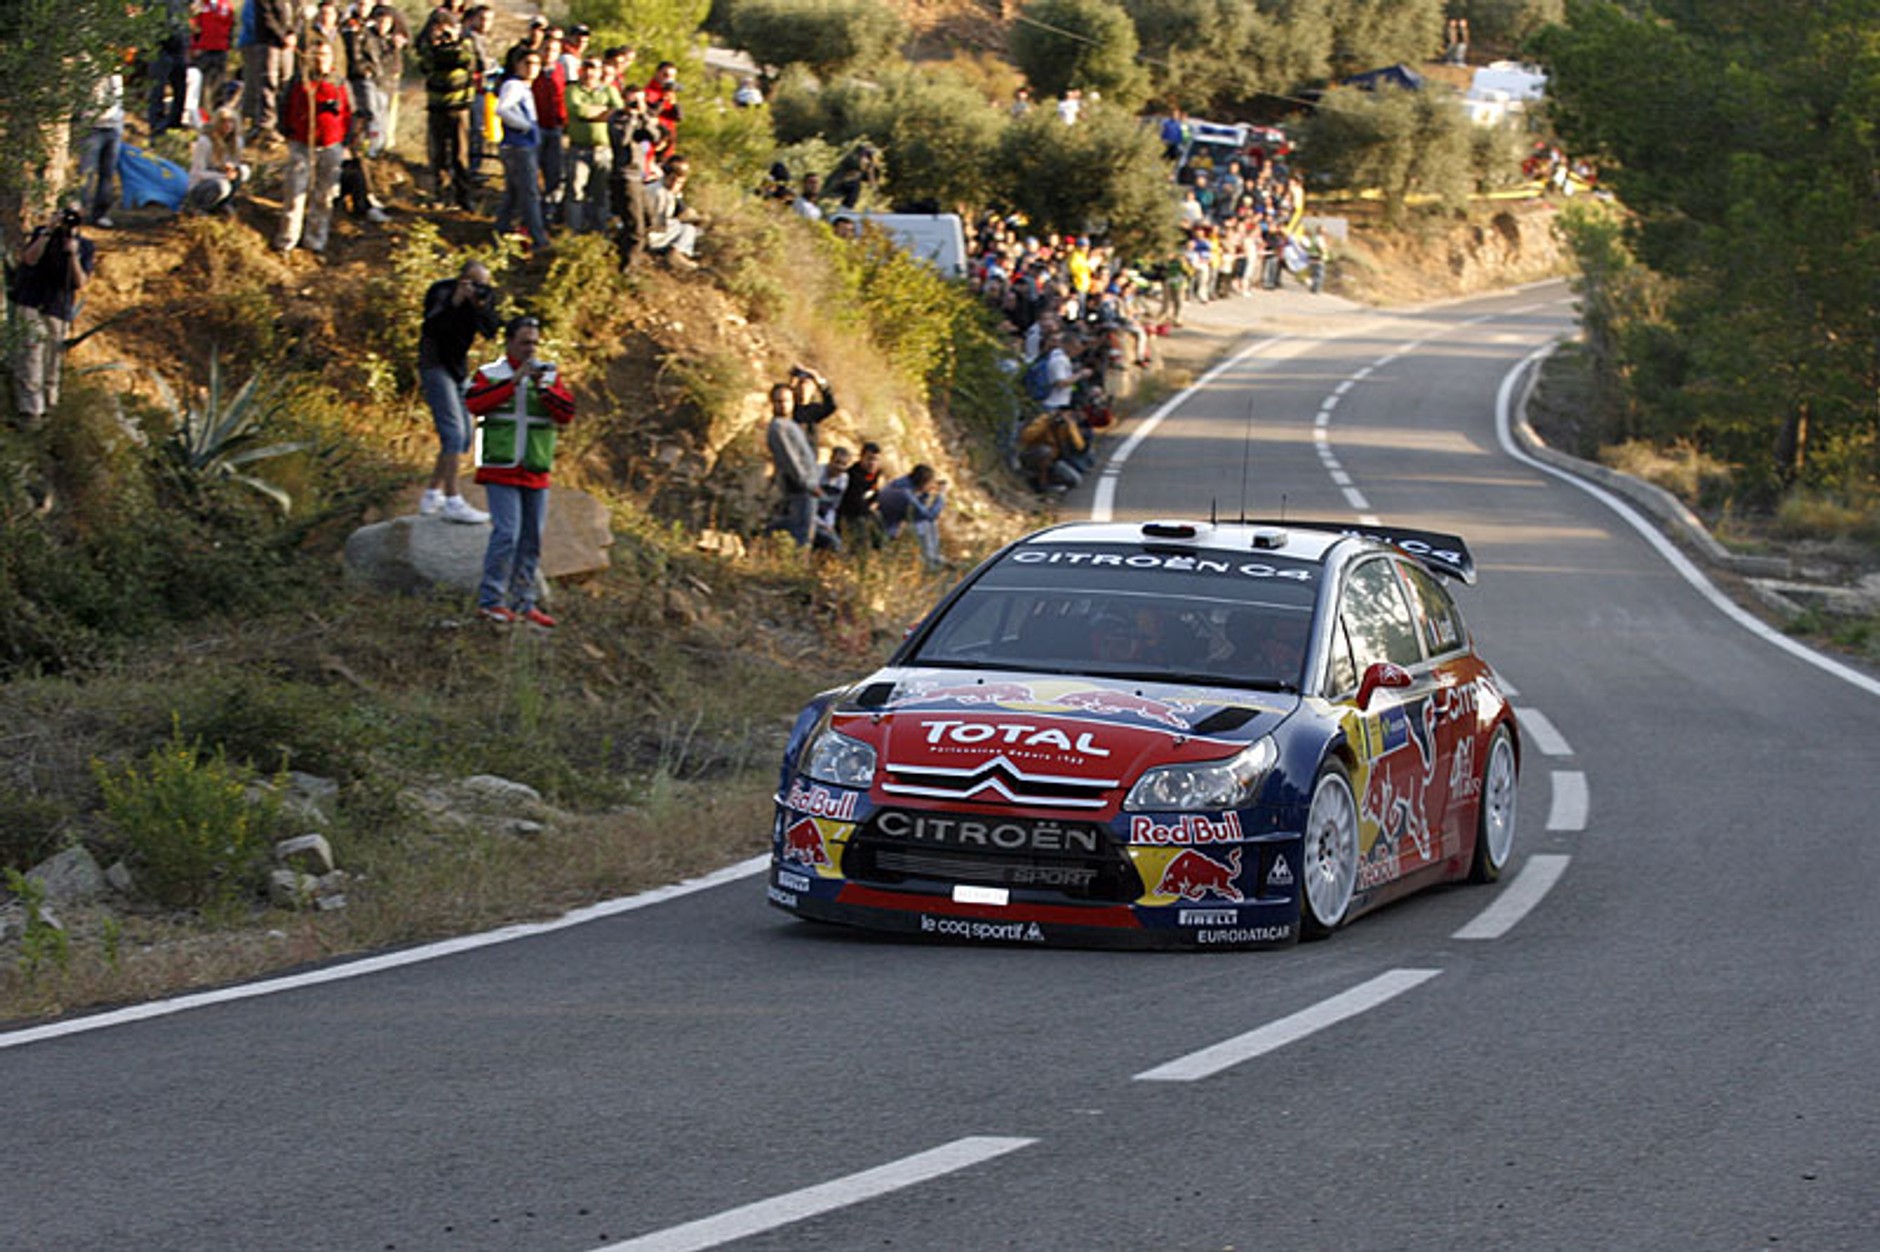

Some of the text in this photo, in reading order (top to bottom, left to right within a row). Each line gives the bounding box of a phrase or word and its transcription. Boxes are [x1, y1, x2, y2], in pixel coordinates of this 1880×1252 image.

[1013, 551, 1312, 581] CITROËN C4
[1399, 540, 1461, 563] C4
[921, 721, 1110, 757] TOTAL
[810, 786, 858, 820] Bull
[877, 812, 1097, 851] CITROËN
[1130, 811, 1243, 844] Red Bull
[1012, 867, 1098, 886] SPORT
[921, 914, 1023, 943] le coq sportif
[1178, 909, 1238, 925] PIRELLI
[1198, 925, 1290, 943] EURODATACAR
